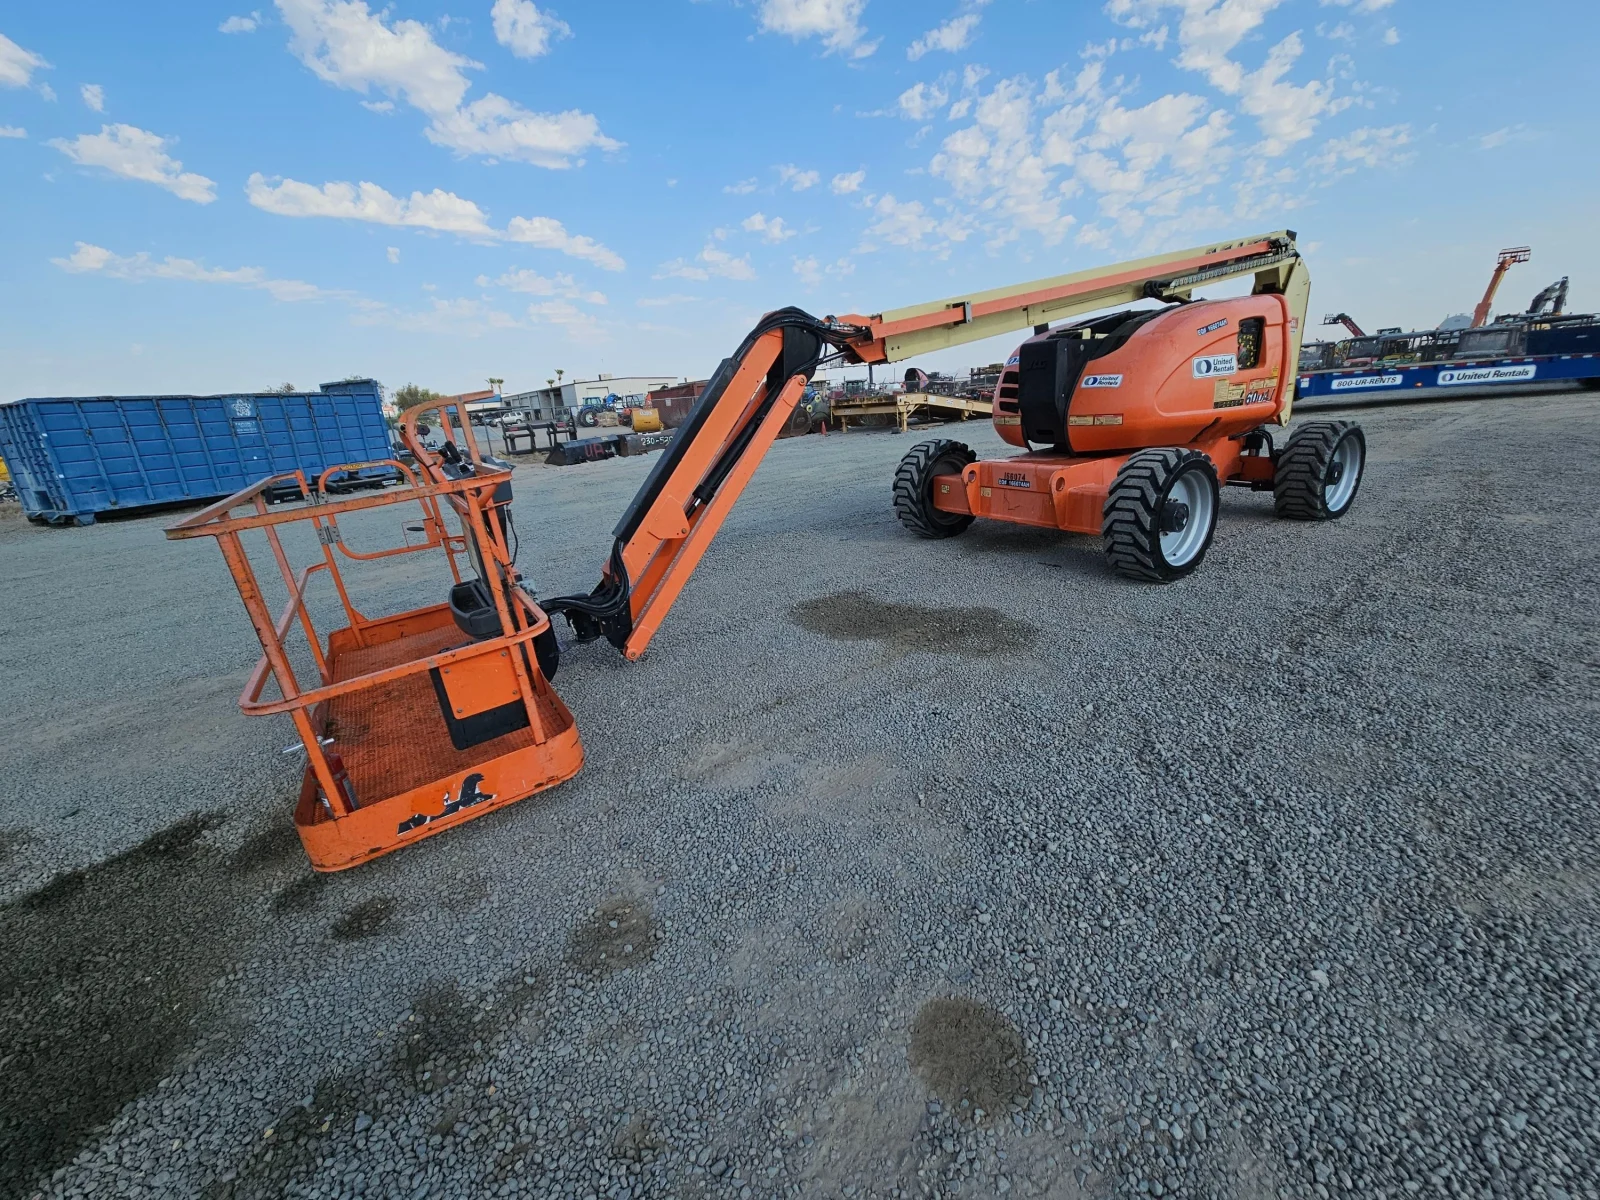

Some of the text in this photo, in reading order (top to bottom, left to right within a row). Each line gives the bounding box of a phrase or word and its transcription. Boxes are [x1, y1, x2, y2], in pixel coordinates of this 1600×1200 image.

[1213, 357, 1233, 366] United
[1213, 365, 1235, 373] Rentals
[1457, 368, 1530, 381] United Rentals
[1337, 376, 1397, 387] 800-UR-RENTS
